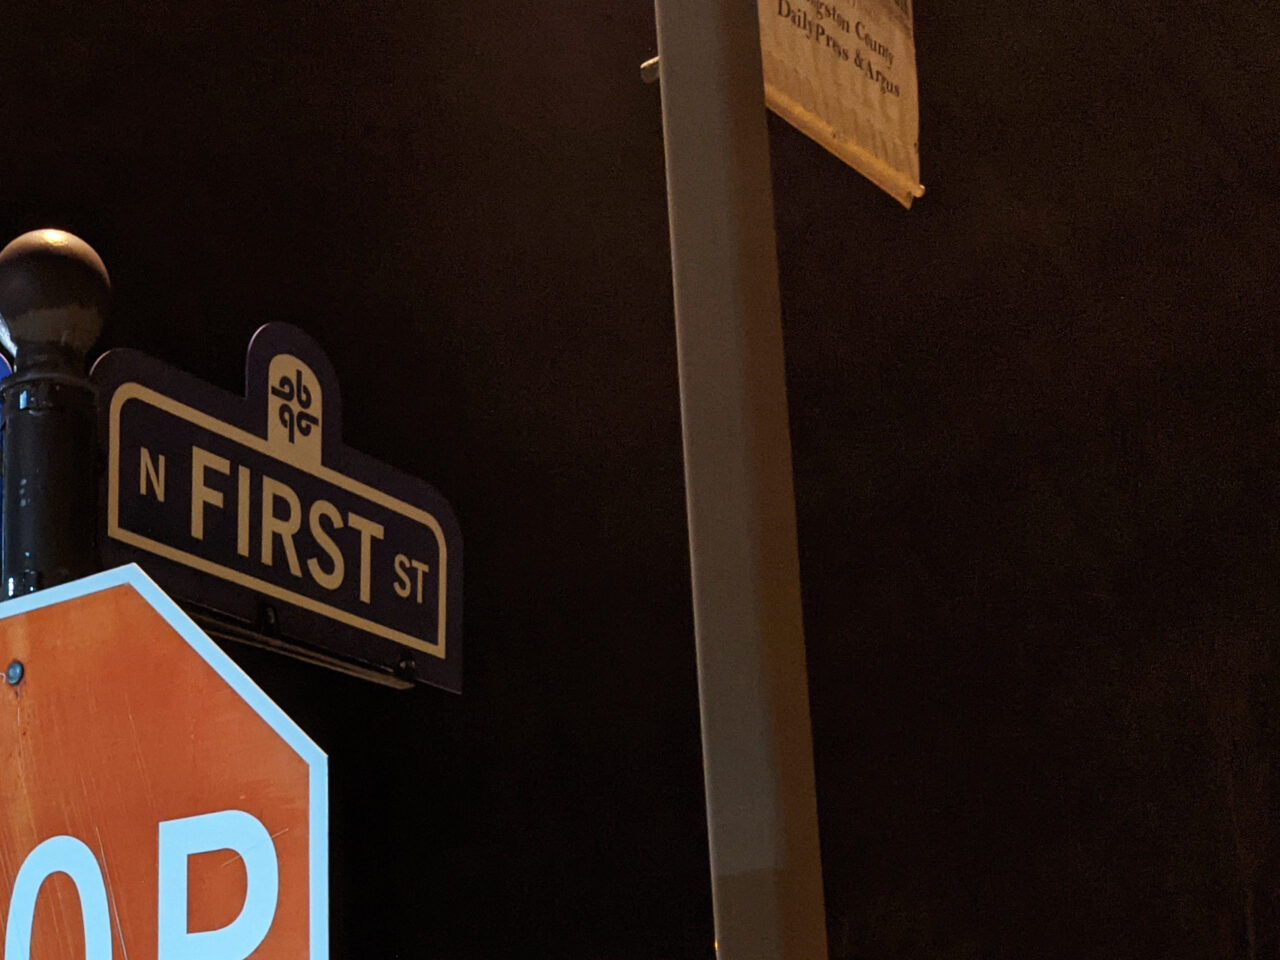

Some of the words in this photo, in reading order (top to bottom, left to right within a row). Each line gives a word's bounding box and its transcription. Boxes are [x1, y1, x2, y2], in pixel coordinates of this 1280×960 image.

[855, 21, 894, 69] County
[140, 446, 165, 502] N
[191, 445, 385, 604] FIRST
[393, 553, 430, 604] ST
